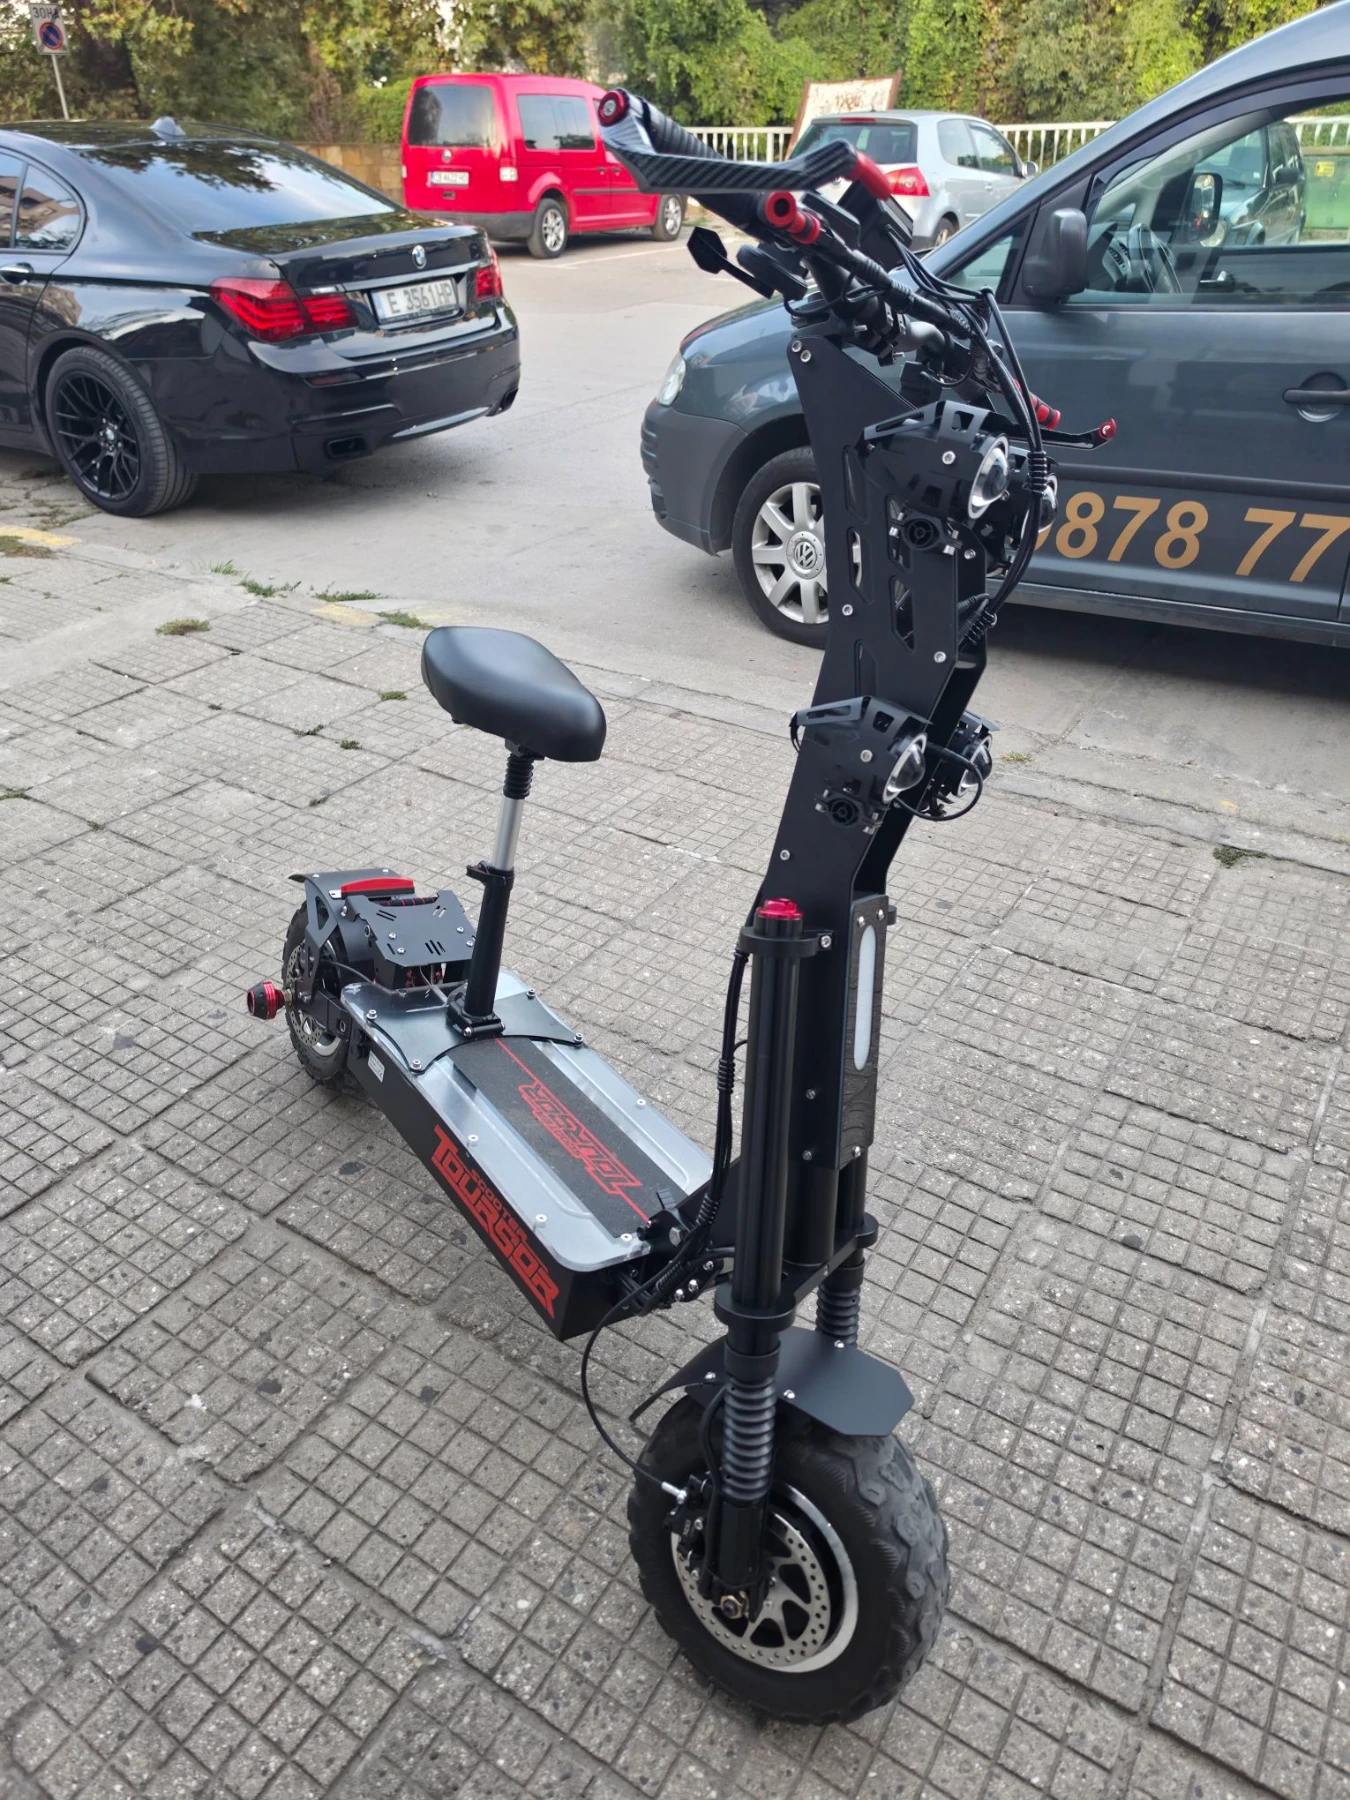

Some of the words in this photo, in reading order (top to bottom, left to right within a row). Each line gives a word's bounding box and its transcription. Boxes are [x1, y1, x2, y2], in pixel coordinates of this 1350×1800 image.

[386, 292, 401, 314] E
[1034, 491, 1208, 569] 878
[431, 1124, 560, 1319] TOURSOR
[471, 1169, 529, 1242] SCOOTER
